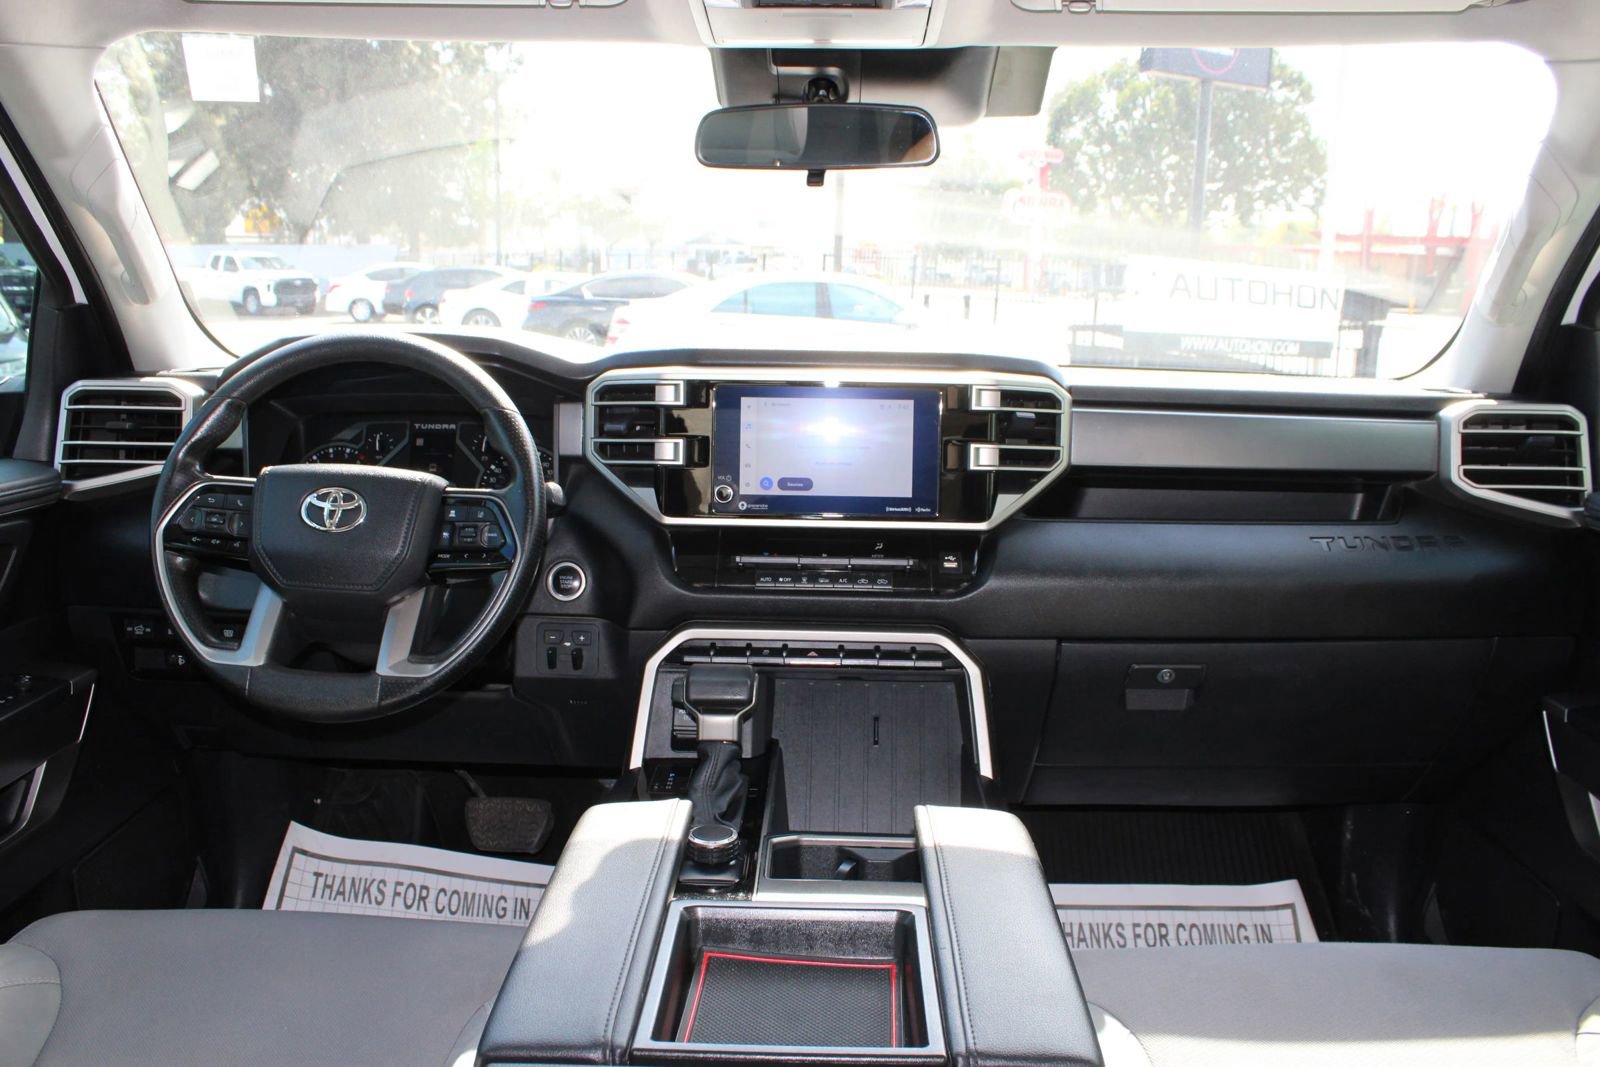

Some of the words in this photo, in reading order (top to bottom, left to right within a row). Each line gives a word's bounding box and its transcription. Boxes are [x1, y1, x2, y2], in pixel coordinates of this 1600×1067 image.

[1169, 273, 1339, 310] AUTOHON
[1180, 336, 1300, 355] WWW.AUTOHON.COM
[311, 871, 387, 904] THANKS
[391, 880, 430, 913] FOR
[435, 887, 508, 919] COMING
[513, 897, 531, 920] IN
[1062, 922, 1126, 949] HANKS
[1133, 922, 1170, 948] FOR
[1176, 923, 1250, 945] COMING
[1256, 924, 1273, 944] IN
